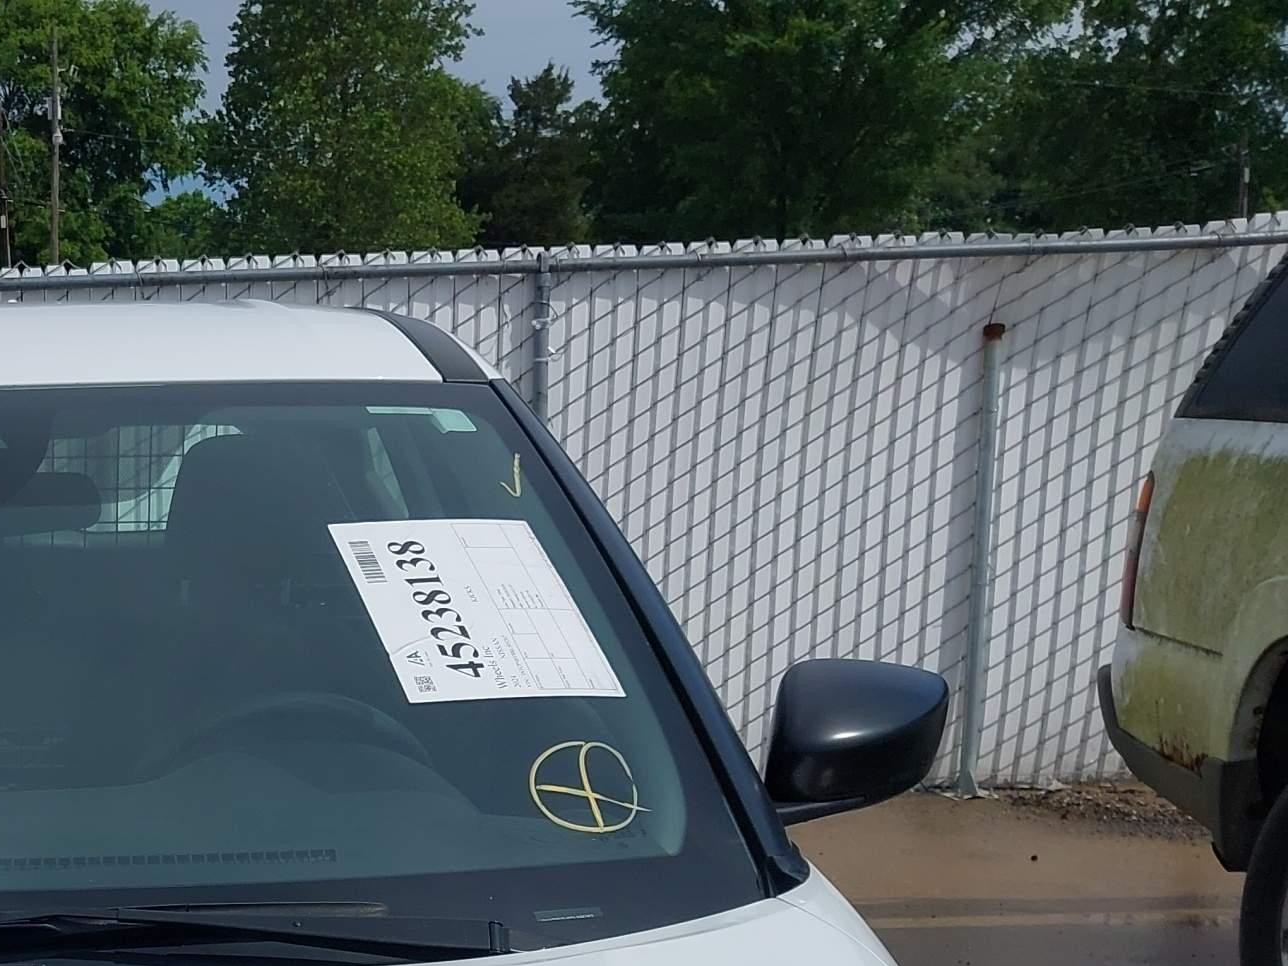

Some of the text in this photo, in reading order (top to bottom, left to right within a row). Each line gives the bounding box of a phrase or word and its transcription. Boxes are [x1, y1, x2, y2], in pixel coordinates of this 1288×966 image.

[387, 540, 485, 678] 45238138
[483, 646, 508, 689] Wheels Inc
